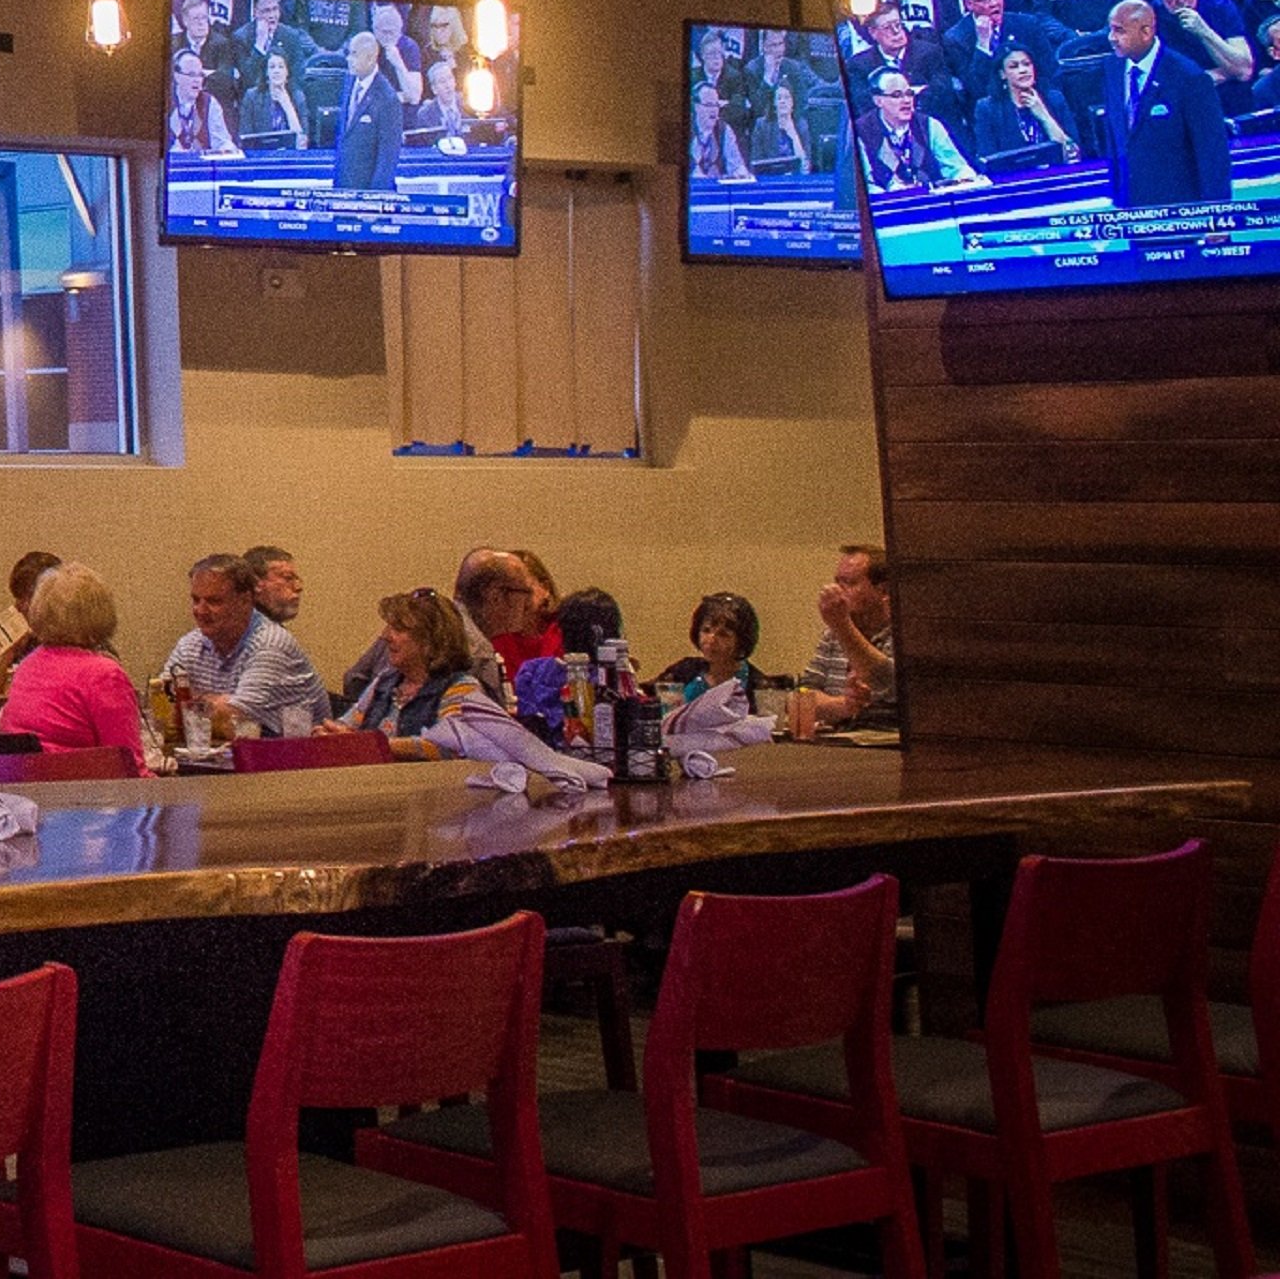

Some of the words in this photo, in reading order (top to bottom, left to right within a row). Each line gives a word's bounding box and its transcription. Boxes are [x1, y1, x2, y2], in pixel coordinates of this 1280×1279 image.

[1049, 215, 1068, 225] BIG
[1069, 212, 1096, 224] EAST
[1097, 208, 1170, 223] TOURNAMENT
[1073, 227, 1092, 239] 42
[1133, 219, 1208, 234] GEORGETOWN
[1216, 217, 1237, 228] 44
[1054, 255, 1099, 268] CANUCKS
